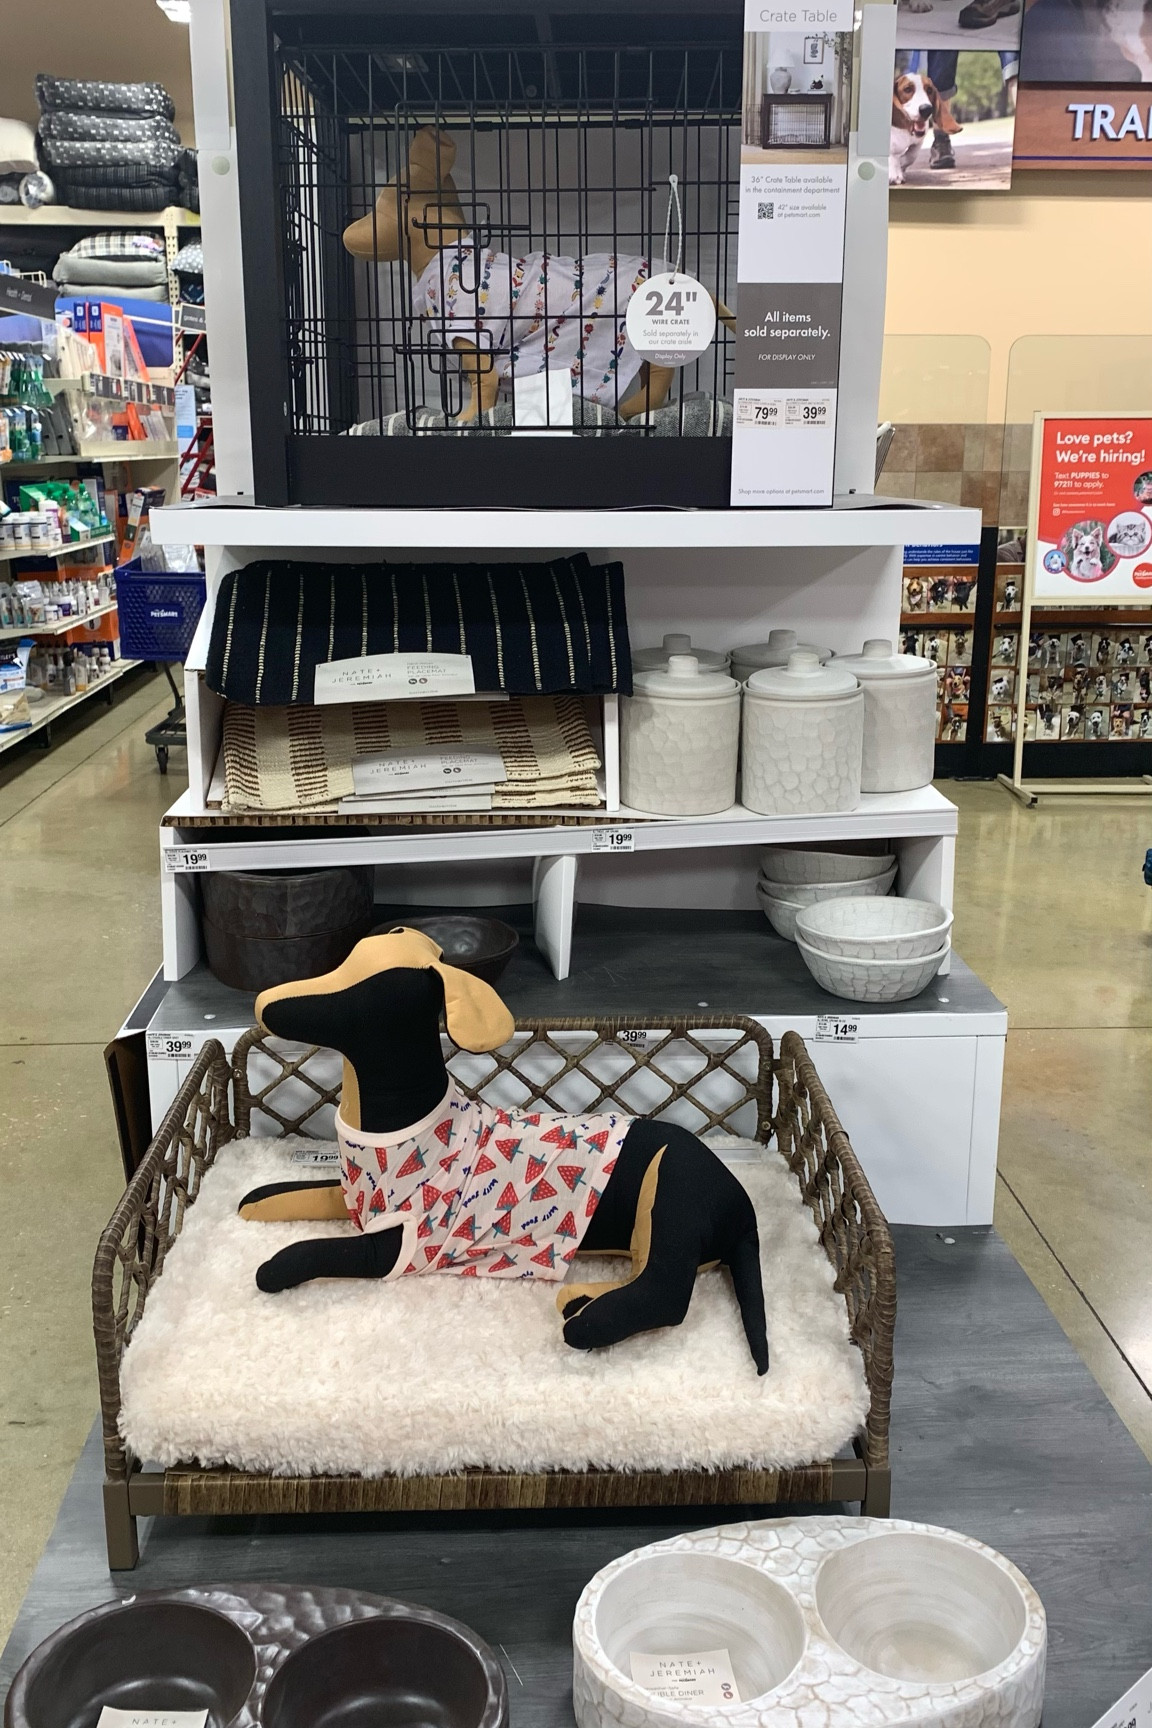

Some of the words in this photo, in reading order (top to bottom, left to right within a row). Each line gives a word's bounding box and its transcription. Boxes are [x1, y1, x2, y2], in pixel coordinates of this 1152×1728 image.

[760, 10, 796, 22] Crate
[802, 10, 837, 22] Table
[765, 176, 782, 184] Crate
[784, 176, 801, 184] Table
[803, 176, 832, 184] available
[804, 186, 840, 195] department
[645, 290, 698, 316] 24"
[764, 311, 780, 322] All
[782, 311, 811, 322] items
[659, 330, 691, 339] separately
[744, 326, 767, 337] sold
[770, 326, 831, 340] separately.
[1057, 432, 1090, 445] Love
[1093, 431, 1134, 447] pets?
[1056, 450, 1096, 463] We're
[1100, 449, 1146, 466] hiring!
[1054, 480, 1073, 488] 97211
[332, 673, 392, 683] JEREMIAH
[370, 764, 427, 774] JEREMIAH
[650, 1668, 716, 1677] JEREMIAH
